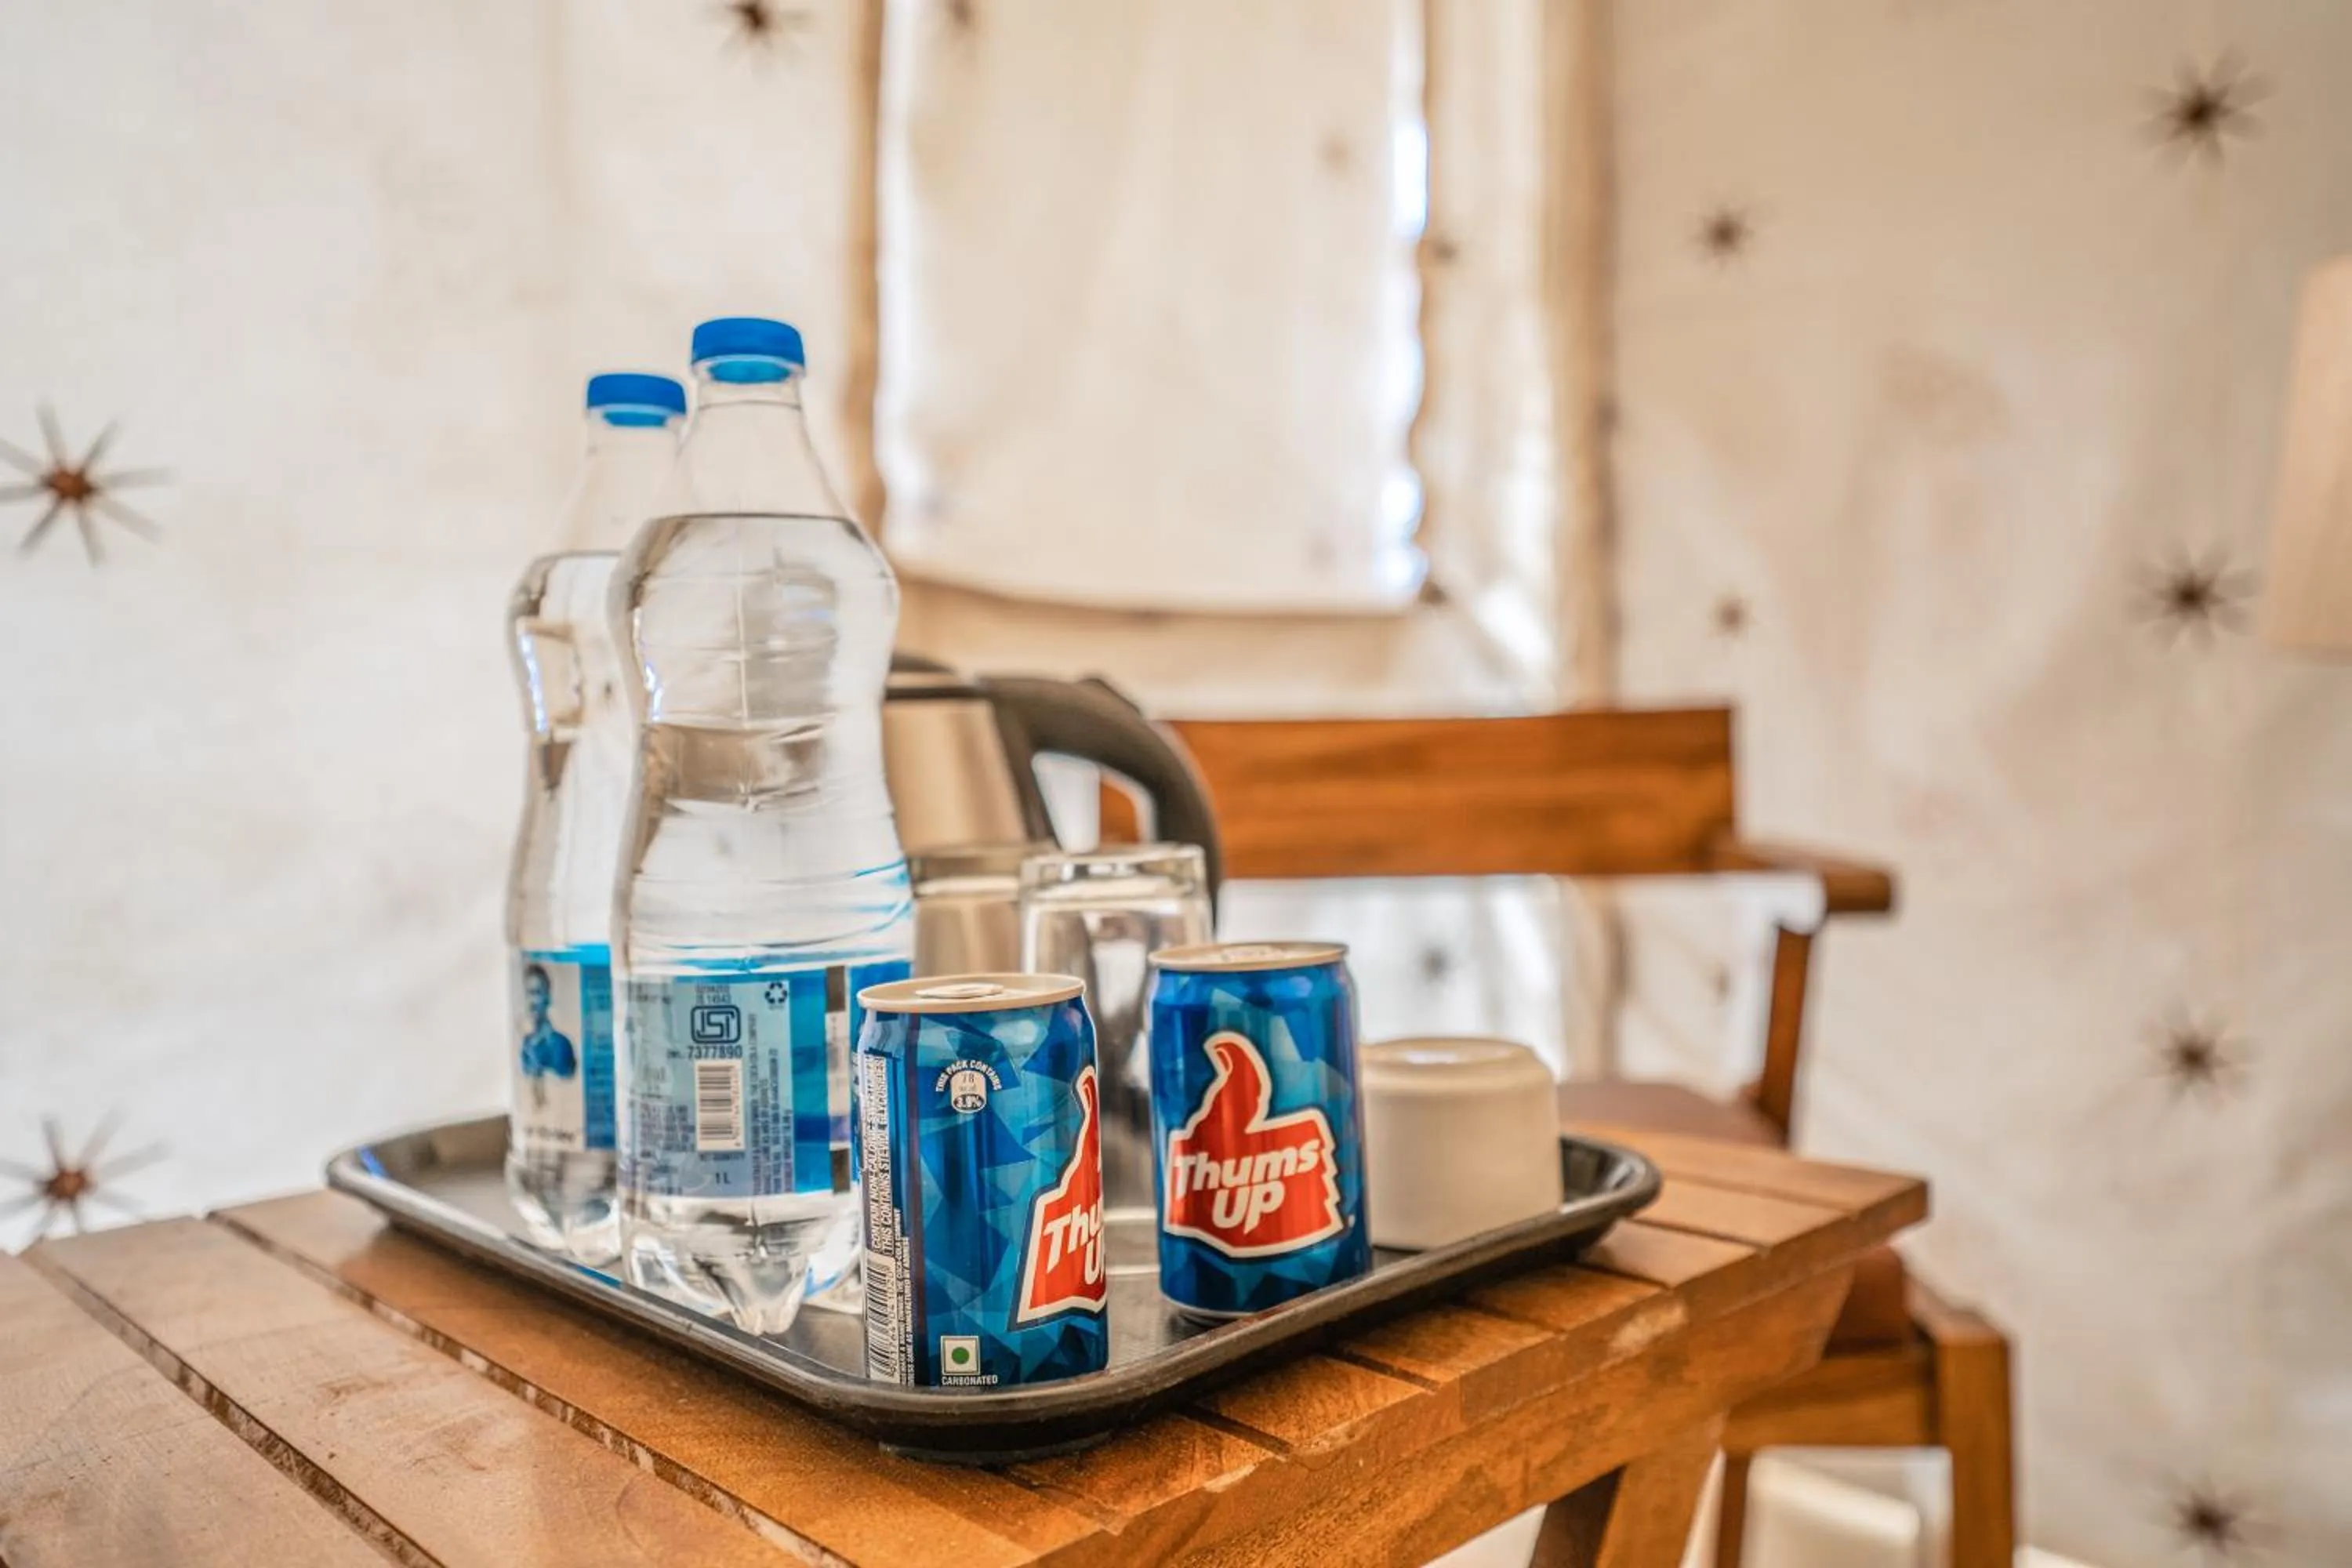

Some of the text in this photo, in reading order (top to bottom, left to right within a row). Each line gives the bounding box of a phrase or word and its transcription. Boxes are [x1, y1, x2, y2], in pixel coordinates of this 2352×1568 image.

[688, 1045, 742, 1058] 7377890
[946, 1061, 967, 1074] PACK
[970, 1060, 1002, 1091] CONTAINS
[1173, 1139, 1320, 1200] Thums
[879, 1173, 891, 1225] CONTAINS
[869, 1201, 881, 1249] CONTAIN
[880, 1228, 892, 1250] THIS
[1043, 1198, 1103, 1274] Thu
[942, 1374, 998, 1385] CARBONATED
